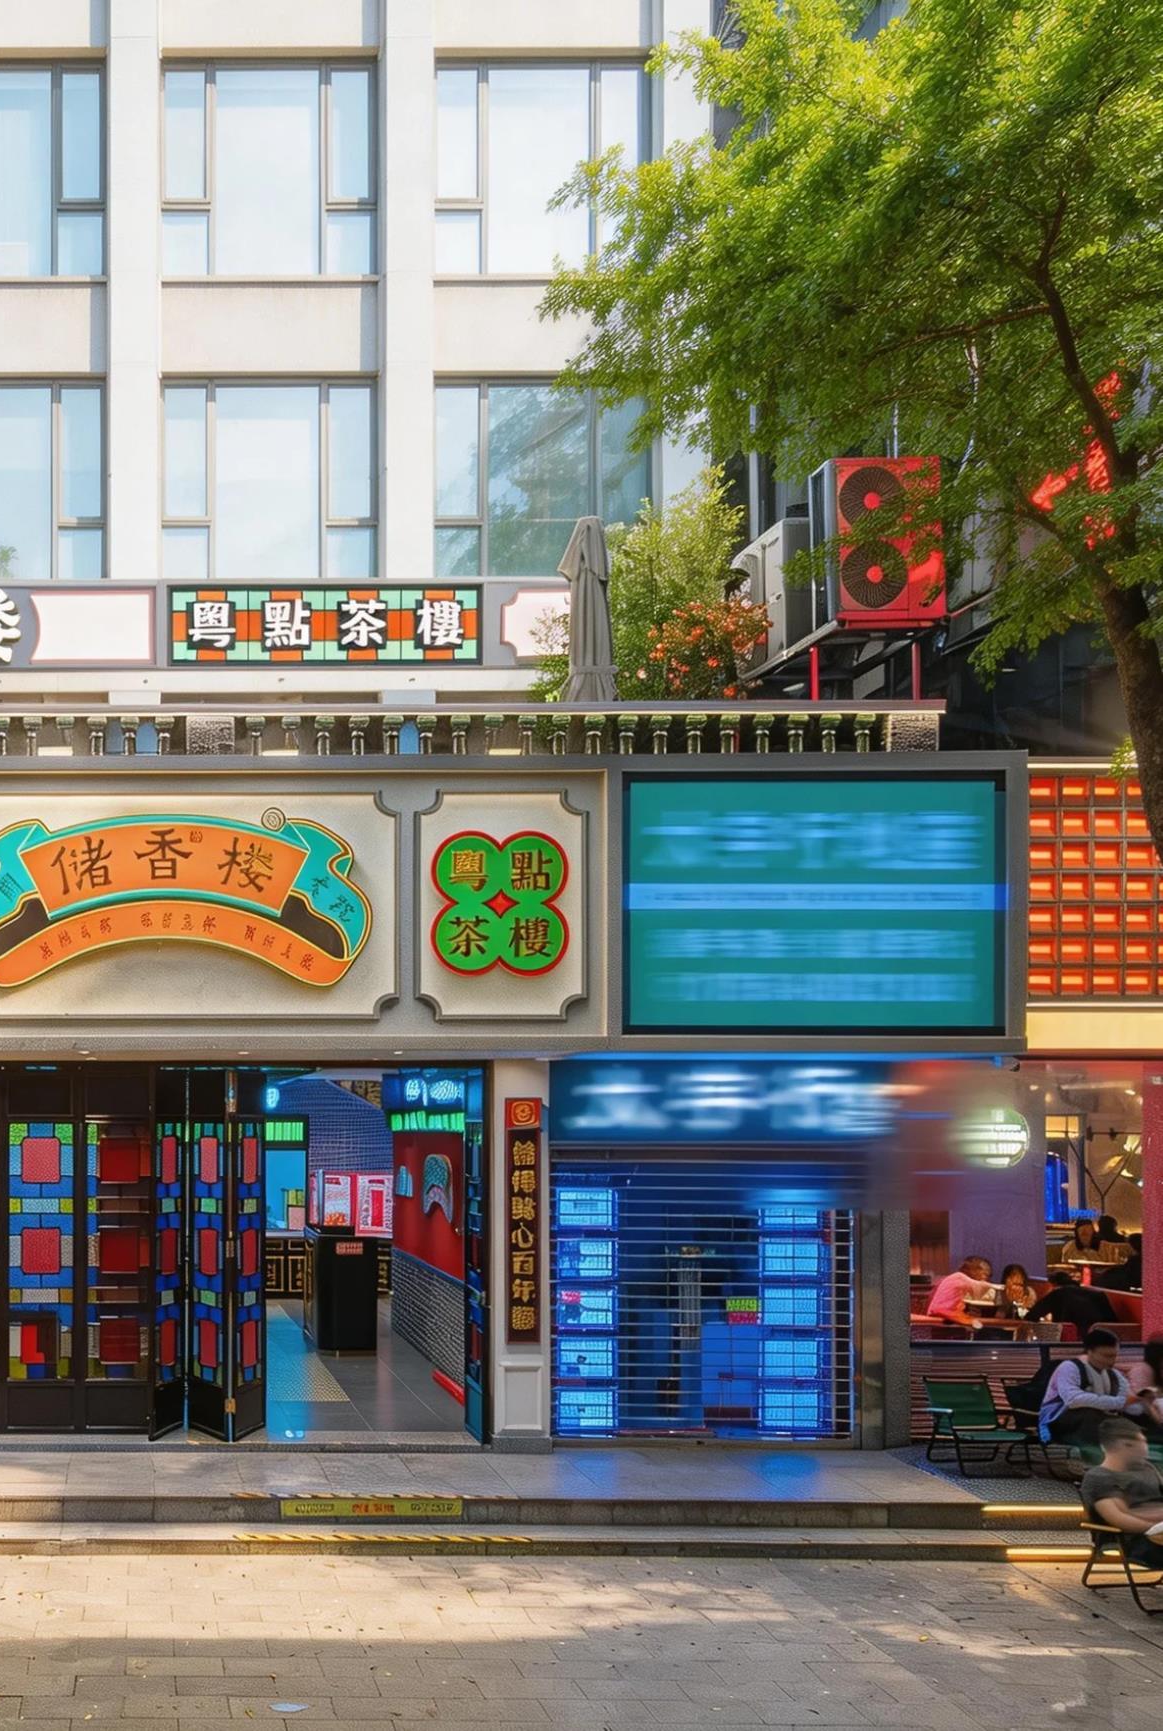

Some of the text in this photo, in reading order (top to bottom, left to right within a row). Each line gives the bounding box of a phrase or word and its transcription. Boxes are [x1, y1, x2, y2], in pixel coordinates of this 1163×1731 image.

[49, 827, 274, 896] 储香楼
[448, 914, 555, 959] 茶樓
